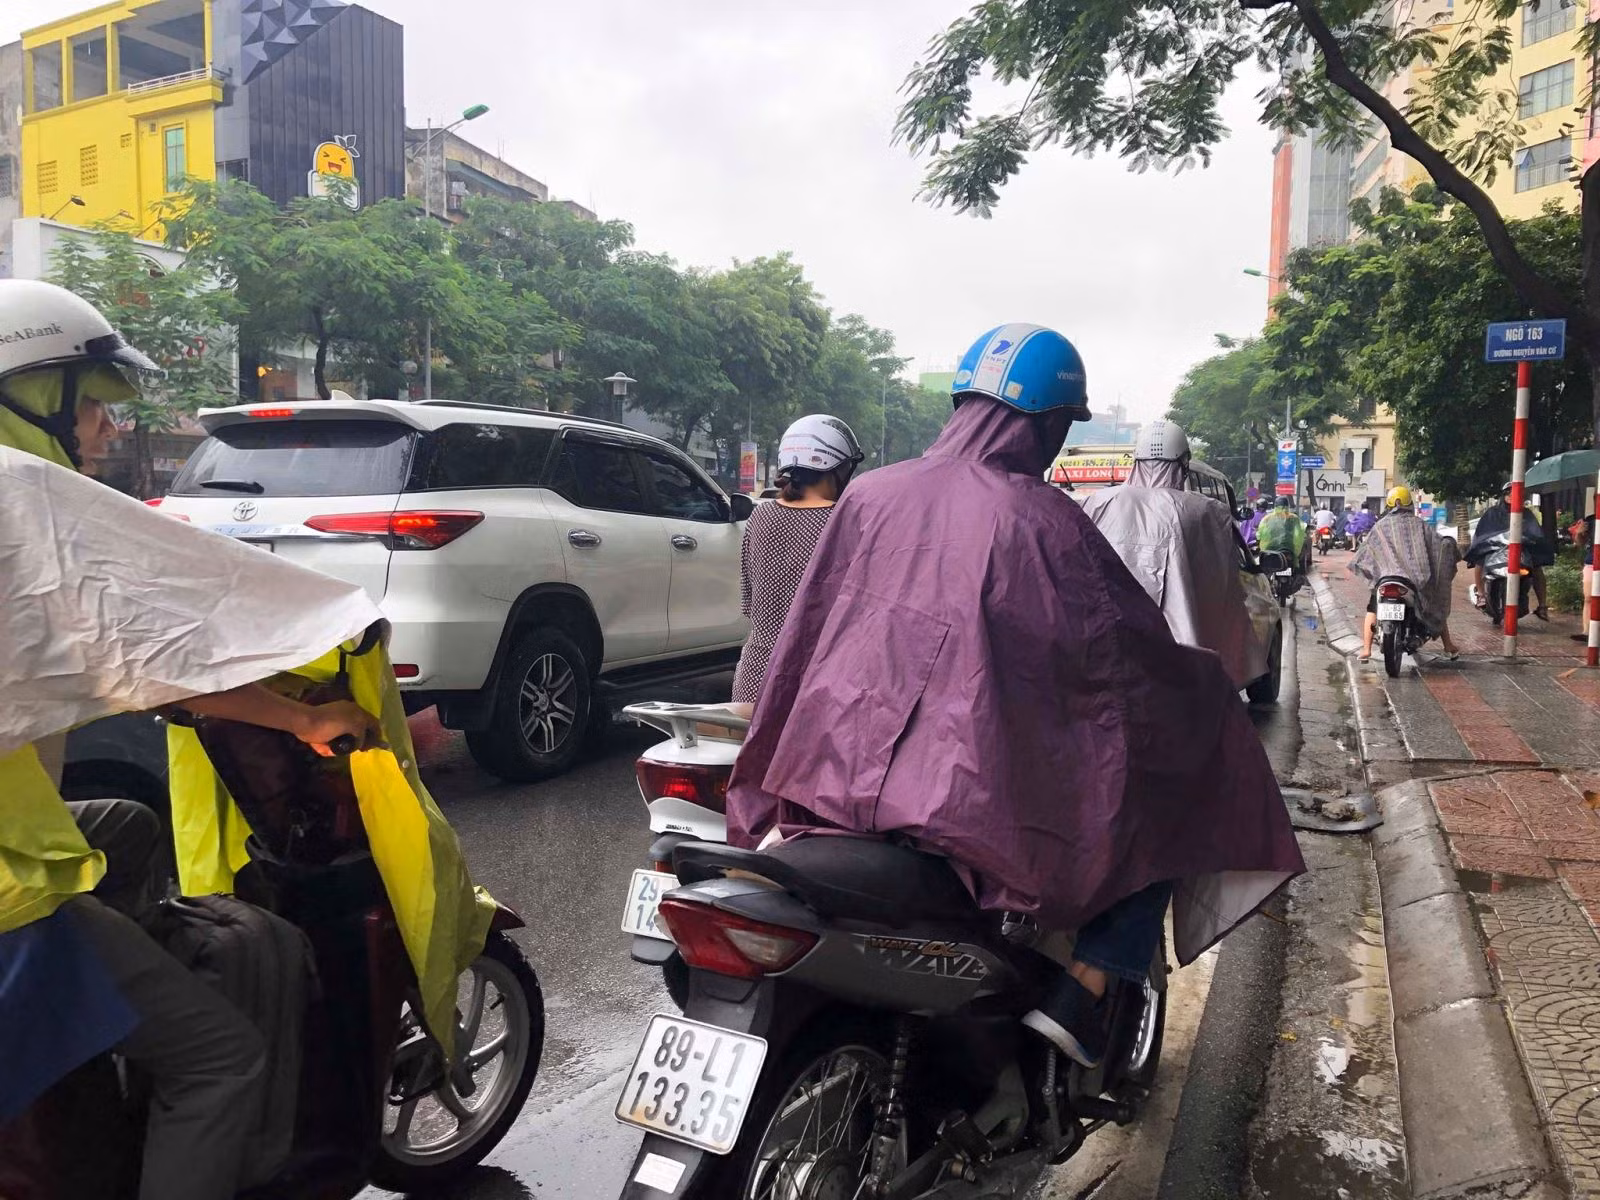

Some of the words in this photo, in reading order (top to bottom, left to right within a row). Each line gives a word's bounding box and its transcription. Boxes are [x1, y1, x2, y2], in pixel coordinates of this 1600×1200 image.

[1505, 325, 1524, 341] NGÕ
[1527, 327, 1543, 340] 163
[1058, 470, 1083, 478] TAXI
[1087, 469, 1114, 477] LONG
[654, 1025, 746, 1088] 89-L1
[628, 1071, 741, 1143] 133.35
